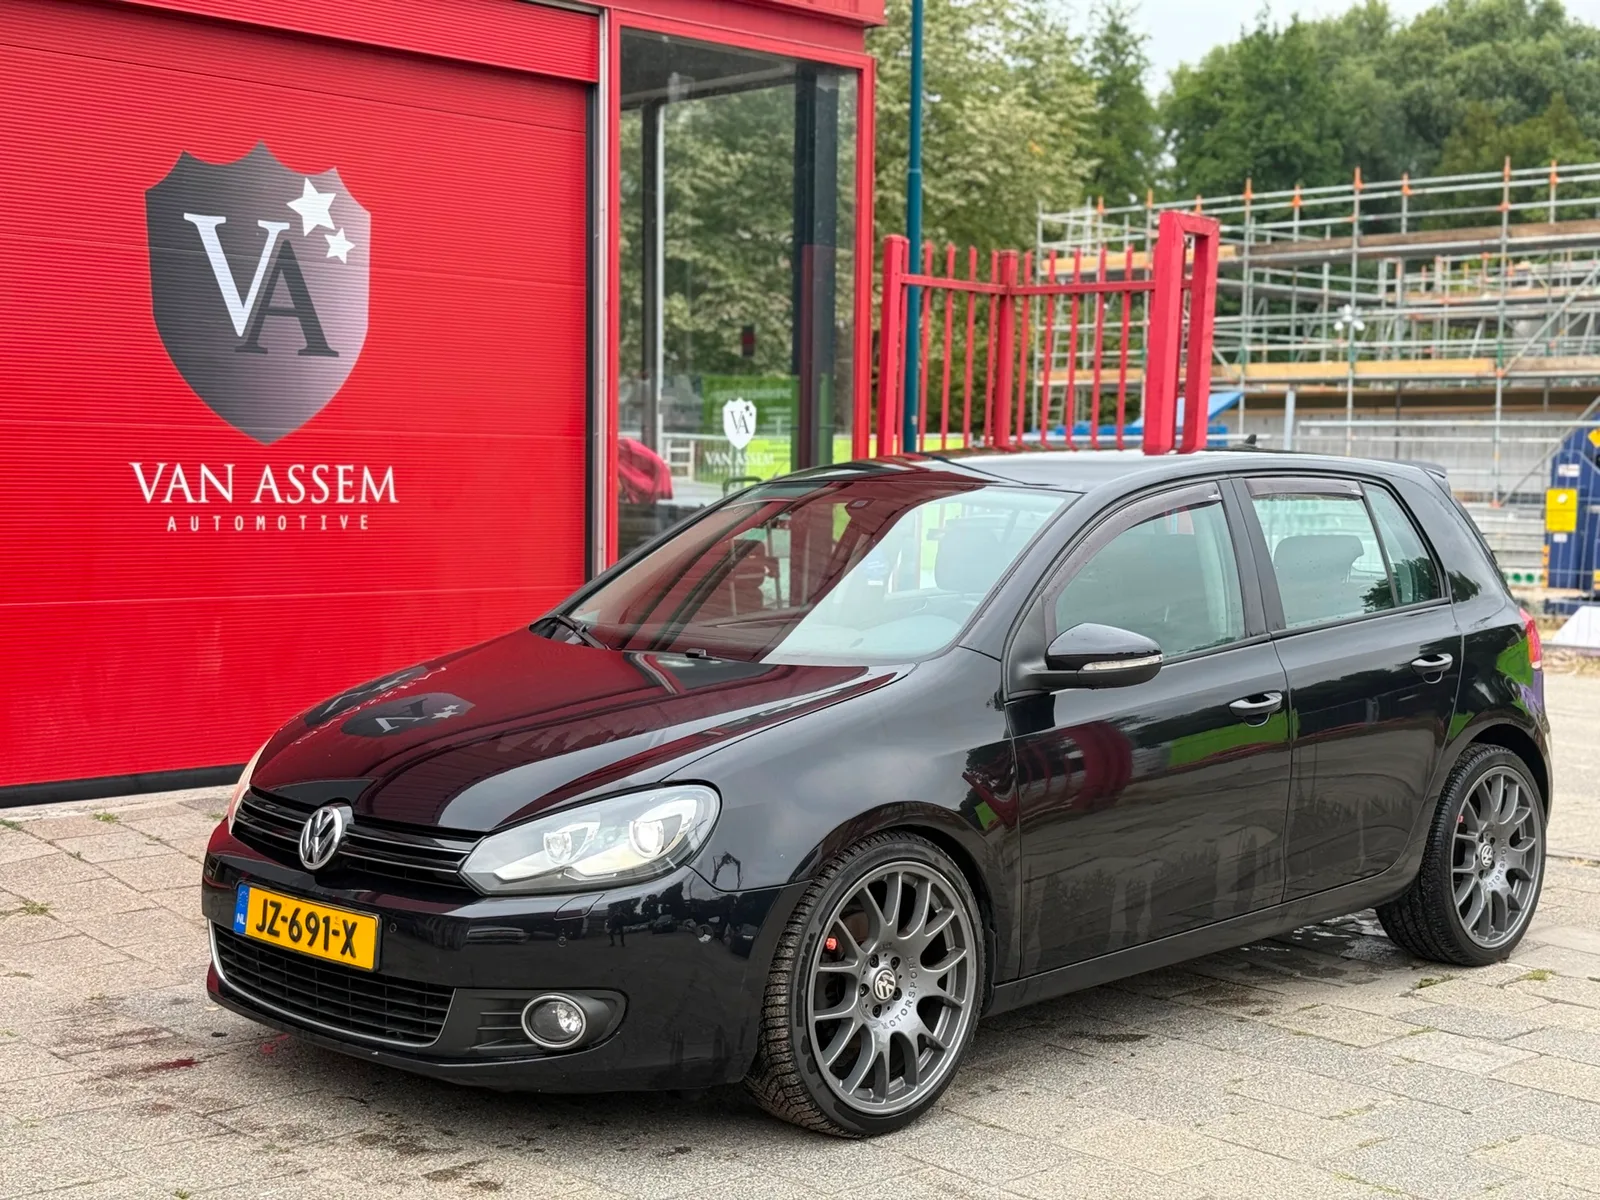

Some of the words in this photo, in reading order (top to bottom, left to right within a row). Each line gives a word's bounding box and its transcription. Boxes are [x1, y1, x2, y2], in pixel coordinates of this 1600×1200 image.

[183, 212, 340, 358] VA
[704, 451, 732, 466] VAN
[128, 462, 236, 505] VAN
[250, 463, 400, 505] ASSEM
[166, 514, 370, 532] AUTOMOTIVE
[236, 913, 246, 925] NL
[256, 898, 358, 959] JZ-691-X
